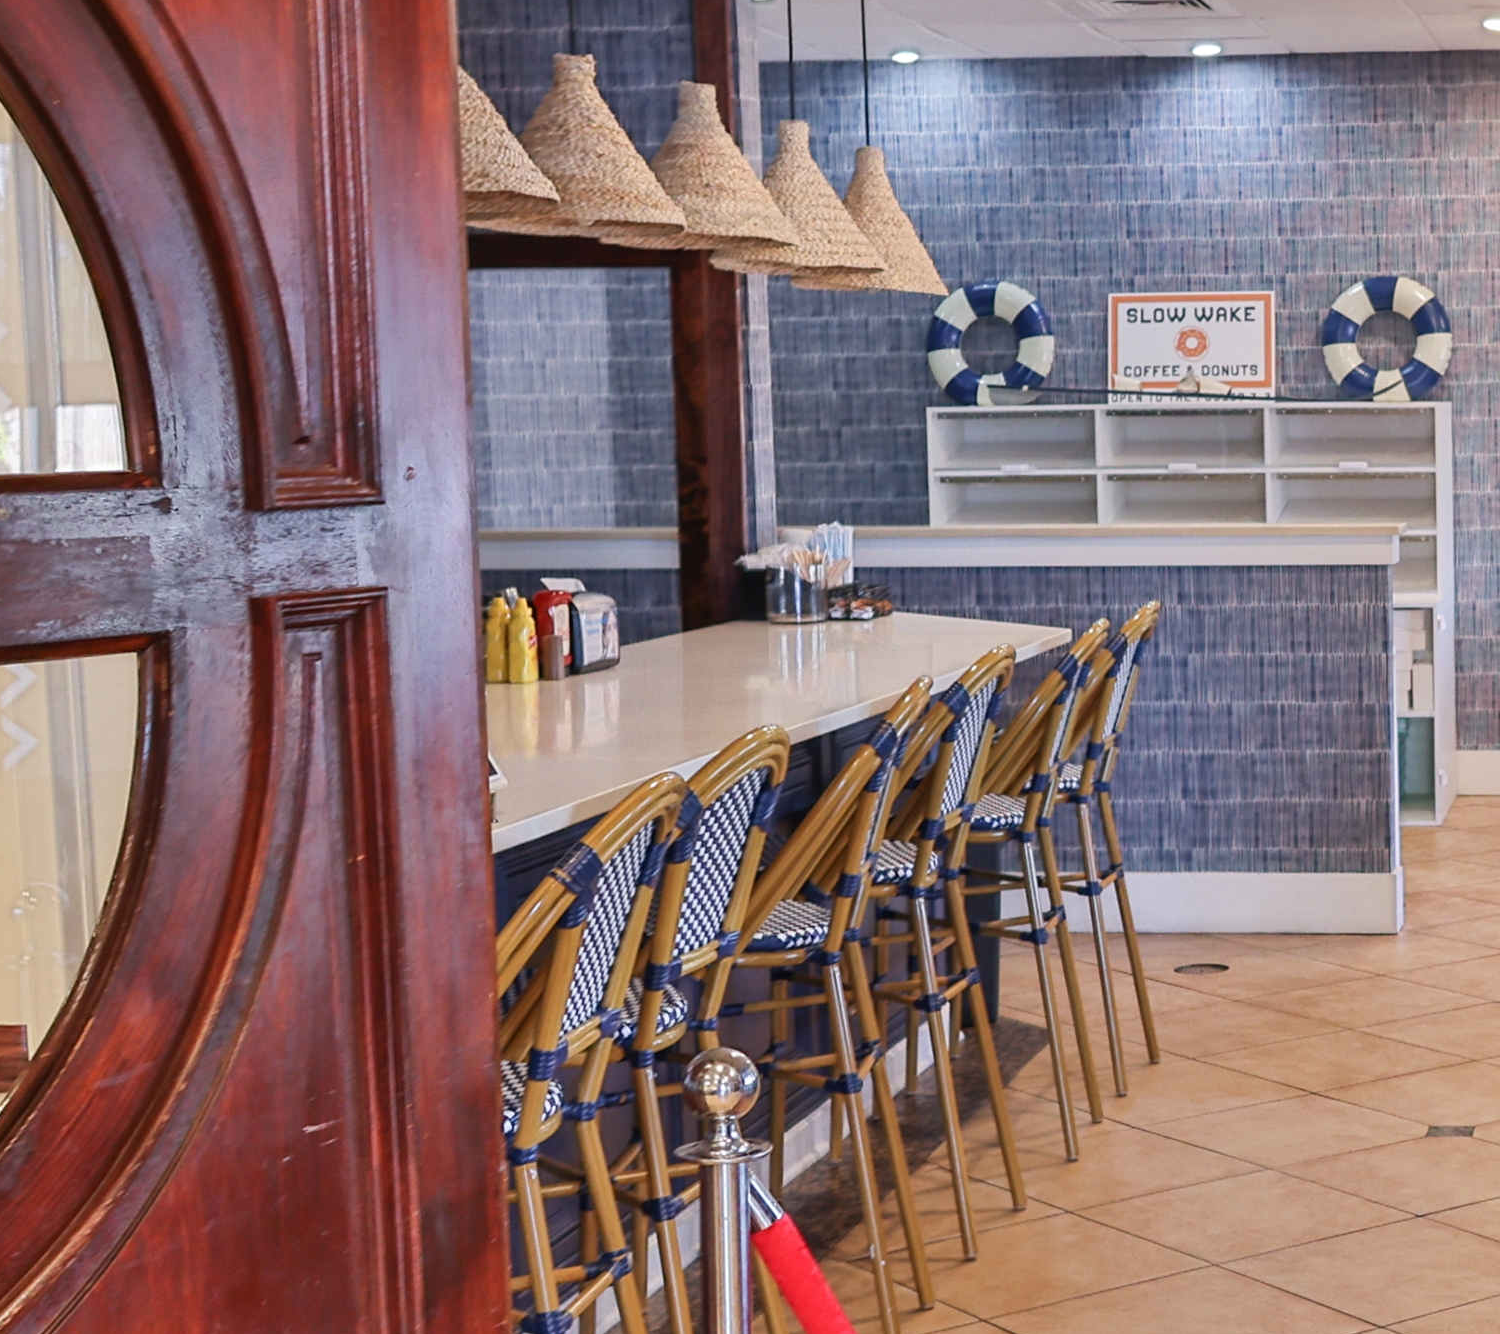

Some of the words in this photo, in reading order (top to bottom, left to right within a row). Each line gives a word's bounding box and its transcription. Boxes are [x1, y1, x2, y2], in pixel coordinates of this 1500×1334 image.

[1126, 307, 1186, 323] SLOW
[1194, 306, 1256, 322] WAKE
[1124, 366, 1180, 377] COFFEE
[1201, 365, 1258, 376] DONUTS
